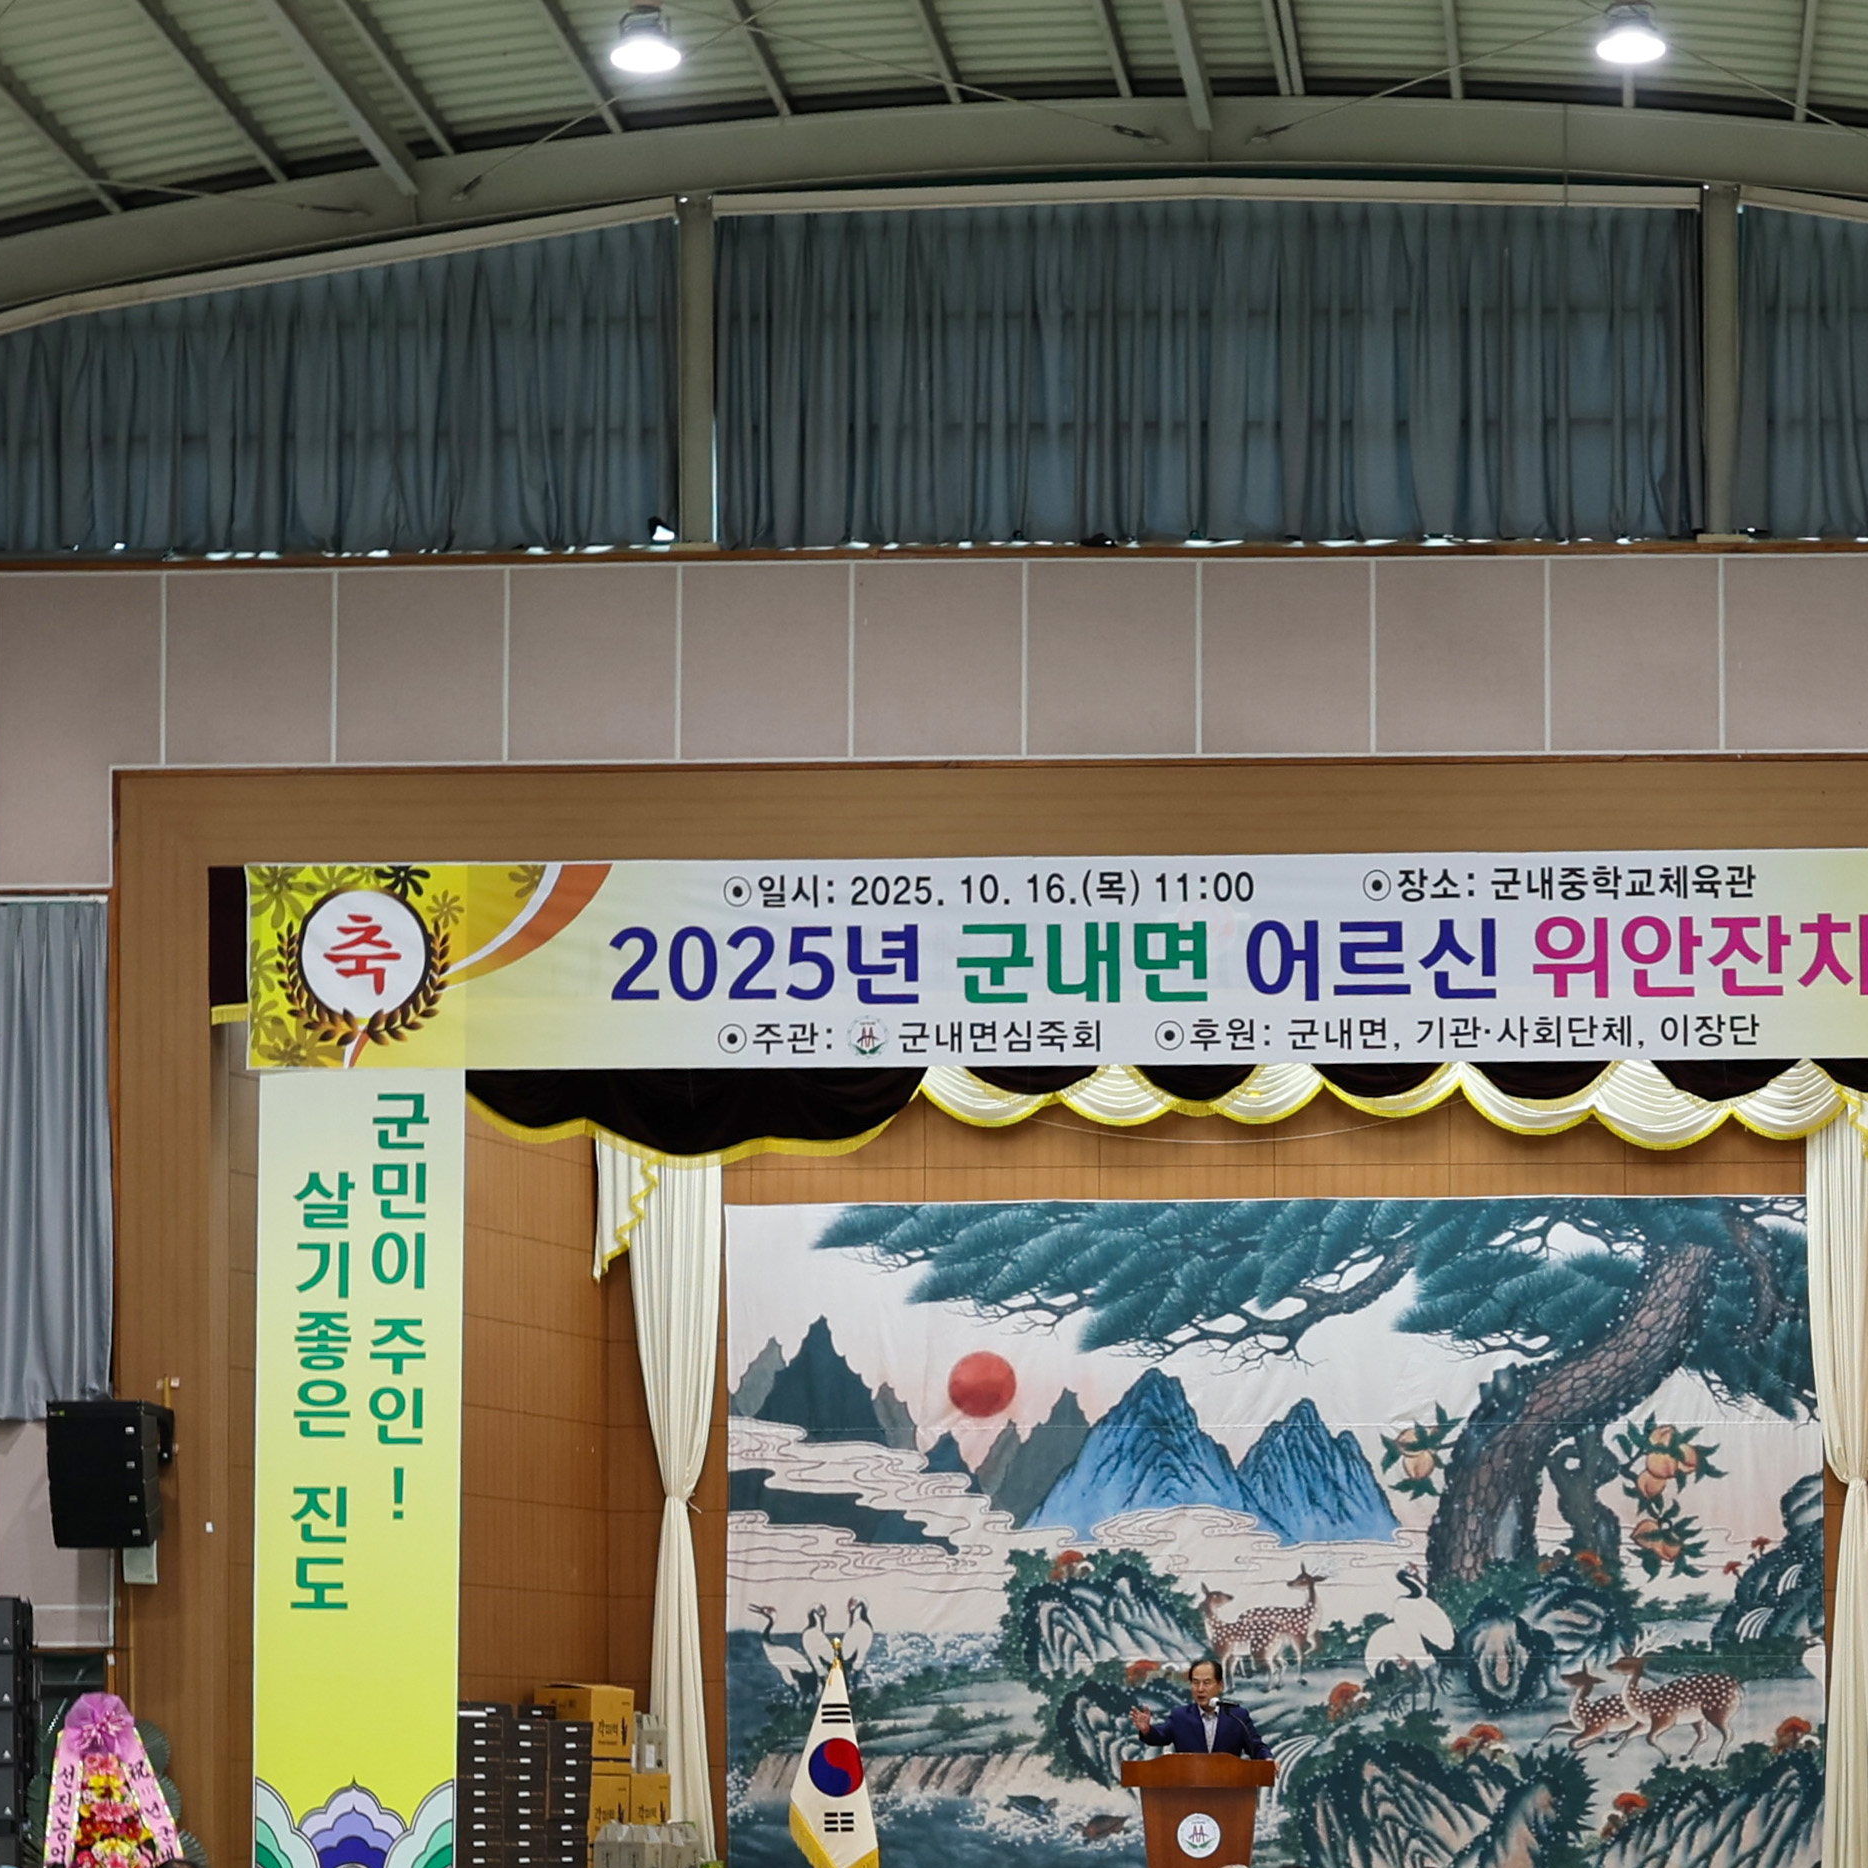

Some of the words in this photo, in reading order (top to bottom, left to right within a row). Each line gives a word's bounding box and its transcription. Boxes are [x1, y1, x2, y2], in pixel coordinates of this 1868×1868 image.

[758, 875, 834, 908] 일시:
[851, 876, 943, 906] 2025.
[961, 874, 1009, 904] 10.
[1028, 870, 1139, 906] 16.(목)
[1156, 872, 1253, 902] 11:00
[1398, 868, 1474, 902] 장소:
[1491, 865, 1756, 900] 군내중학교체육관
[323, 911, 403, 996] 축
[609, 924, 919, 1004] 2025년
[957, 921, 1207, 1003] 군내면
[1246, 918, 1496, 1001] 어르신
[753, 1023, 832, 1054] 주관:
[899, 1020, 1100, 1053] 군내면심죽회
[1190, 1019, 1270, 1051] 후원:
[1288, 1018, 1399, 1051] 군내면,
[1661, 1014, 1759, 1046] 이장단
[372, 1093, 429, 1289] 군민이
[291, 1487, 348, 1609] 진도
